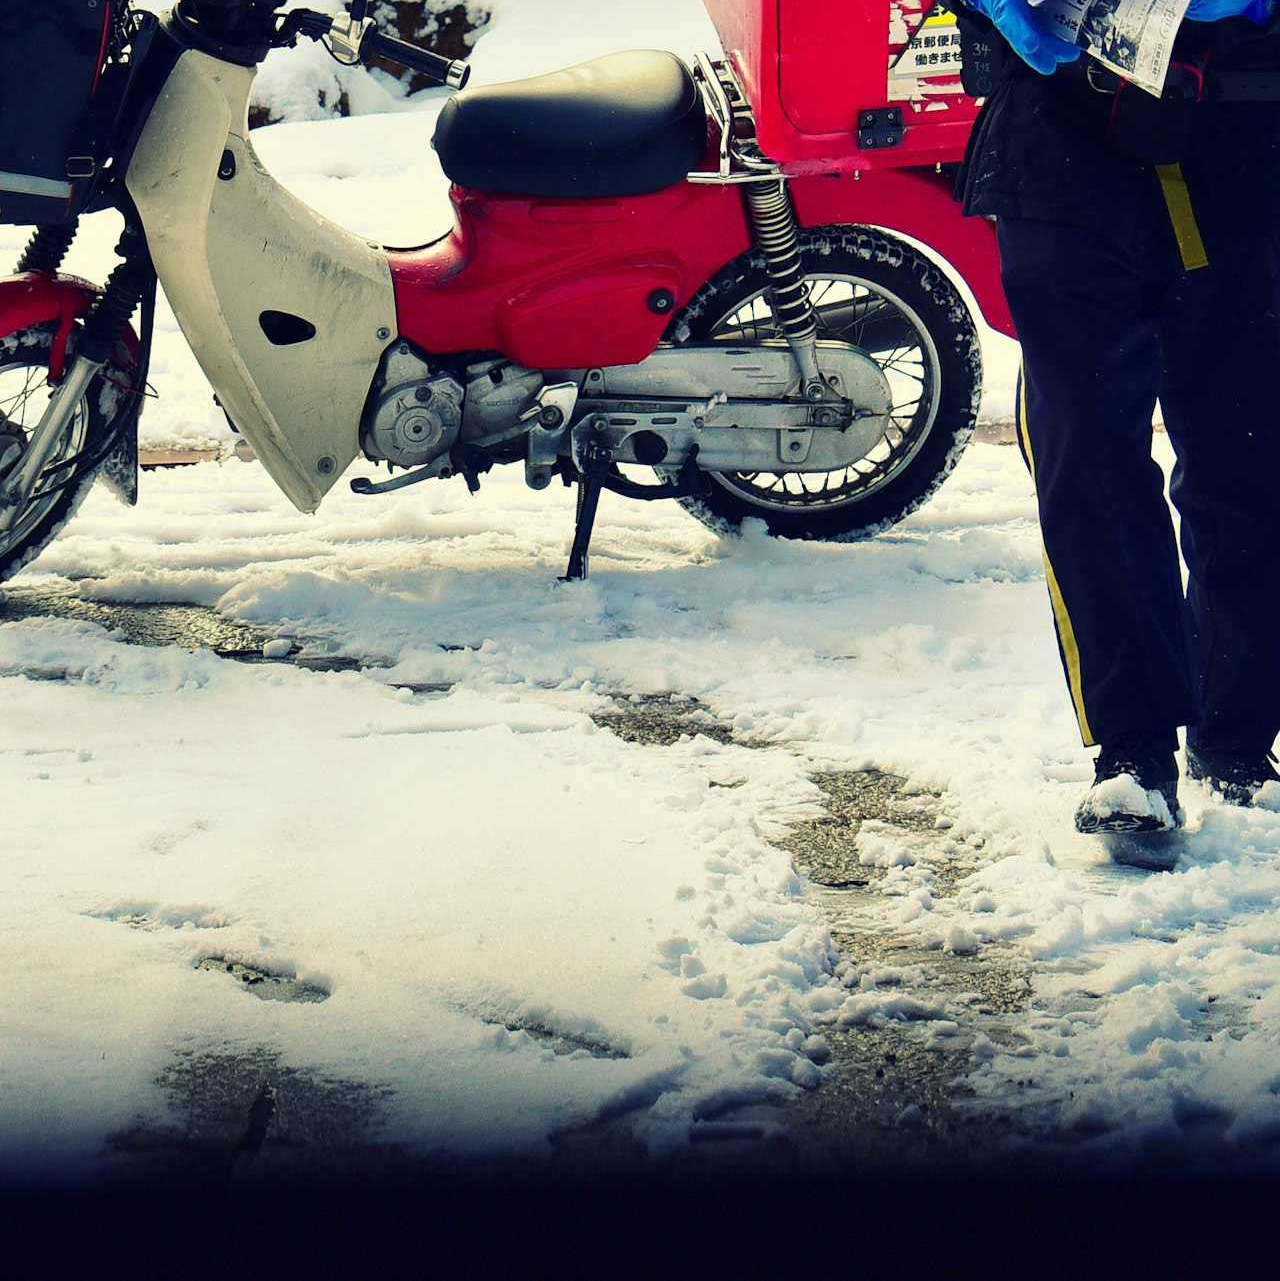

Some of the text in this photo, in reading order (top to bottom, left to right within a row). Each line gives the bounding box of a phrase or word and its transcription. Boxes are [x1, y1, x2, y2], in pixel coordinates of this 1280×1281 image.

[907, 34, 961, 50] 京郵便局
[972, 42, 991, 58] 34
[915, 52, 962, 65] 働きませ
